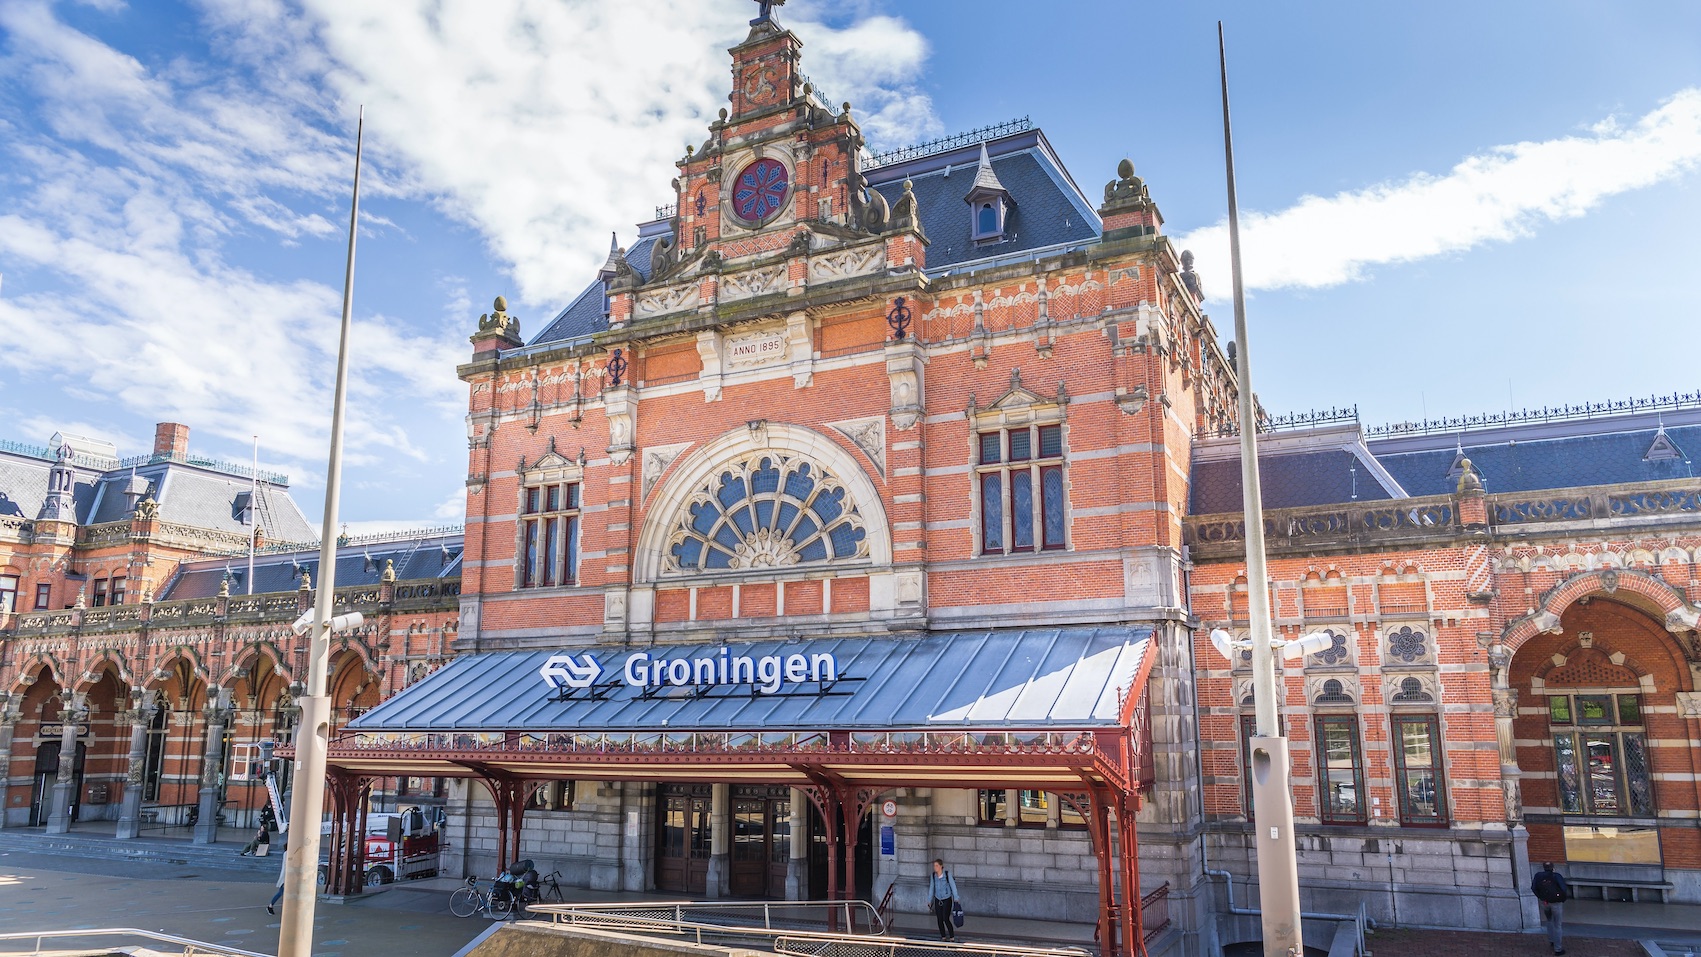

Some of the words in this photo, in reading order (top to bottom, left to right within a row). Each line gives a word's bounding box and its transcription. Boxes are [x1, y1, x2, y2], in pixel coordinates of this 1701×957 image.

[733, 344, 756, 356] ANNO
[759, 340, 779, 352] 1895
[624, 647, 837, 694] Groningen
